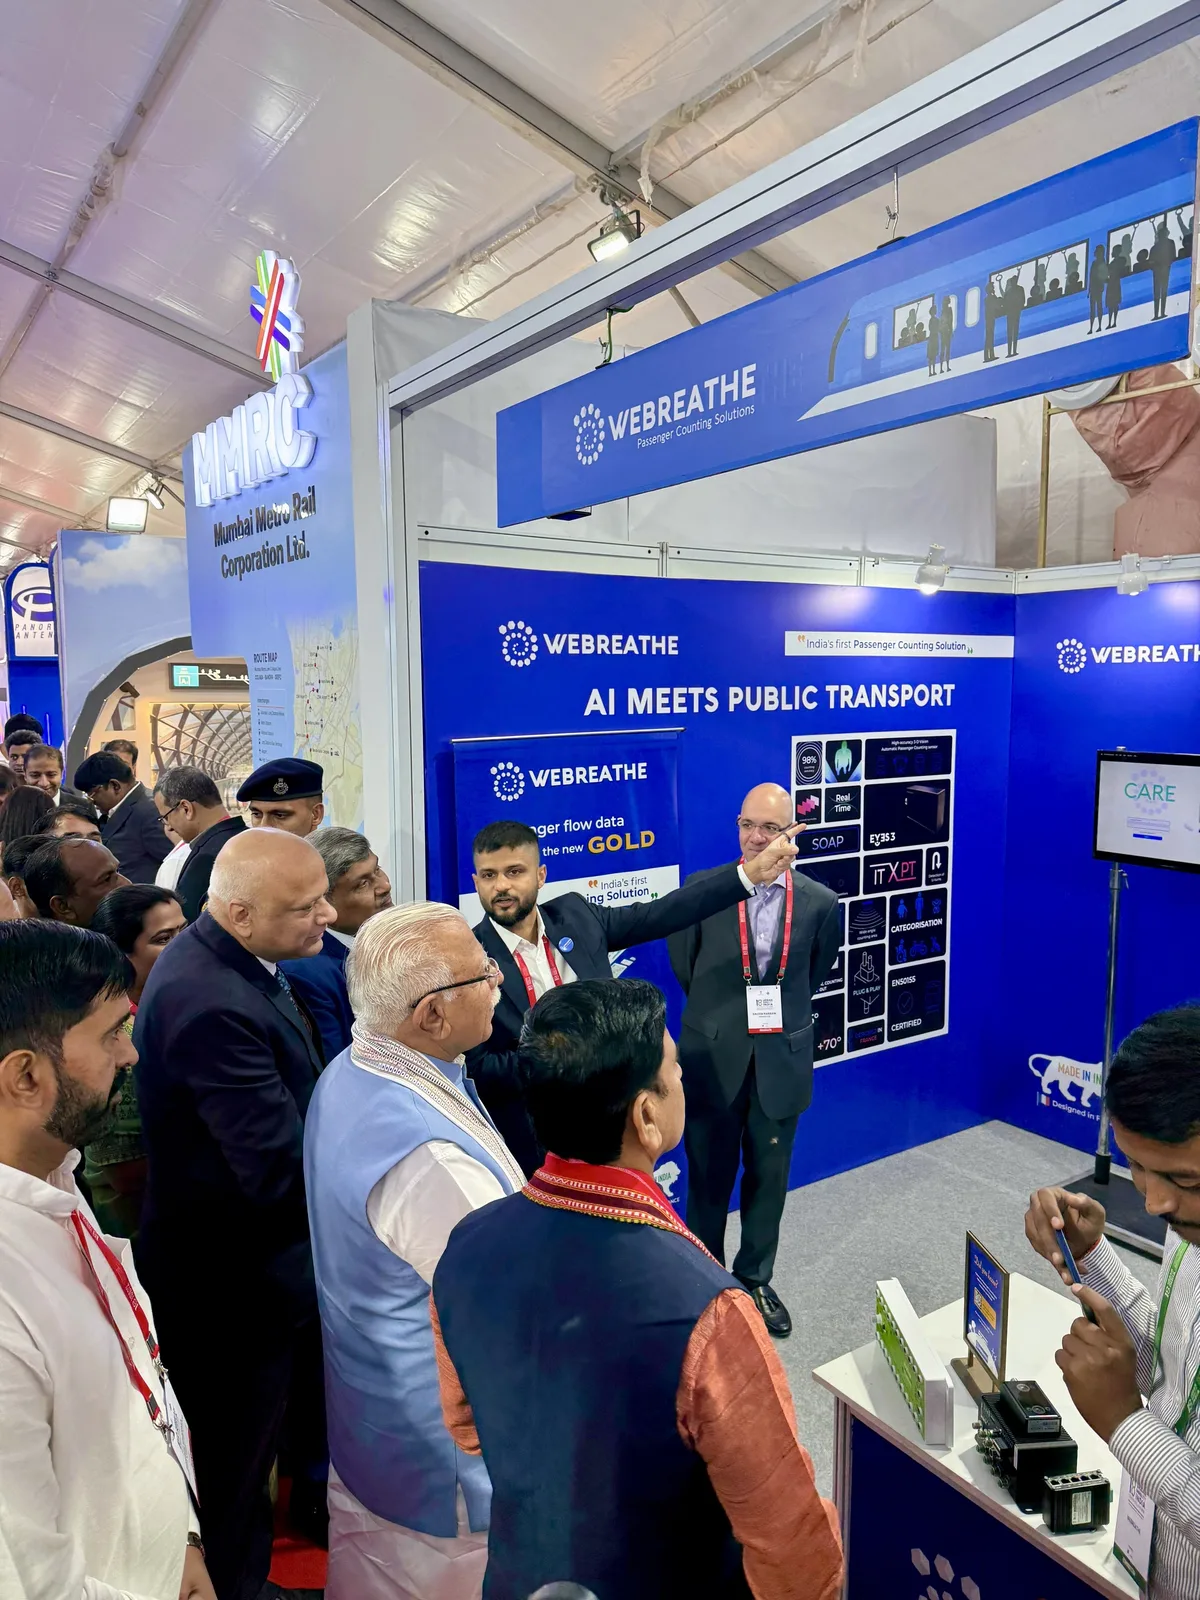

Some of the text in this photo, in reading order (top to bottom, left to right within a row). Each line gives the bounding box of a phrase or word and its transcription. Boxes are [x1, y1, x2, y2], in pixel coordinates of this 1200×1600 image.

[608, 363, 757, 441] WEBREATHE
[637, 405, 755, 449] Passenger Counting Solutions
[192, 373, 318, 507] MMRC
[213, 485, 316, 547] Mumbai Metro Rail
[221, 530, 310, 581] Corporation Ltd.
[542, 633, 679, 655] WEBREATHE
[835, 639, 852, 649] first
[853, 640, 896, 651] Passenger
[897, 640, 933, 652] Counting
[583, 683, 956, 716] AI MEETS PUBLIC TRANSPORT
[801, 755, 817, 764] 98%
[529, 762, 648, 787] WEBREATHE
[835, 793, 851, 802] Real
[1124, 782, 1176, 802] CARE
[834, 804, 851, 812] Time
[563, 819, 592, 832] flow
[595, 816, 625, 829] data
[542, 830, 655, 856] the new GOLD
[812, 835, 844, 850] SOAP
[631, 876, 648, 886] first
[607, 887, 649, 901] Solution
[890, 918, 943, 933] CATEGORISATION
[852, 987, 866, 996] PLUG
[891, 1018, 922, 1031] CERTIFIED
[1057, 1062, 1080, 1078] MADE
[1082, 1069, 1091, 1082] IN
[1052, 1099, 1086, 1117] Designed
[1087, 1111, 1095, 1120] in
